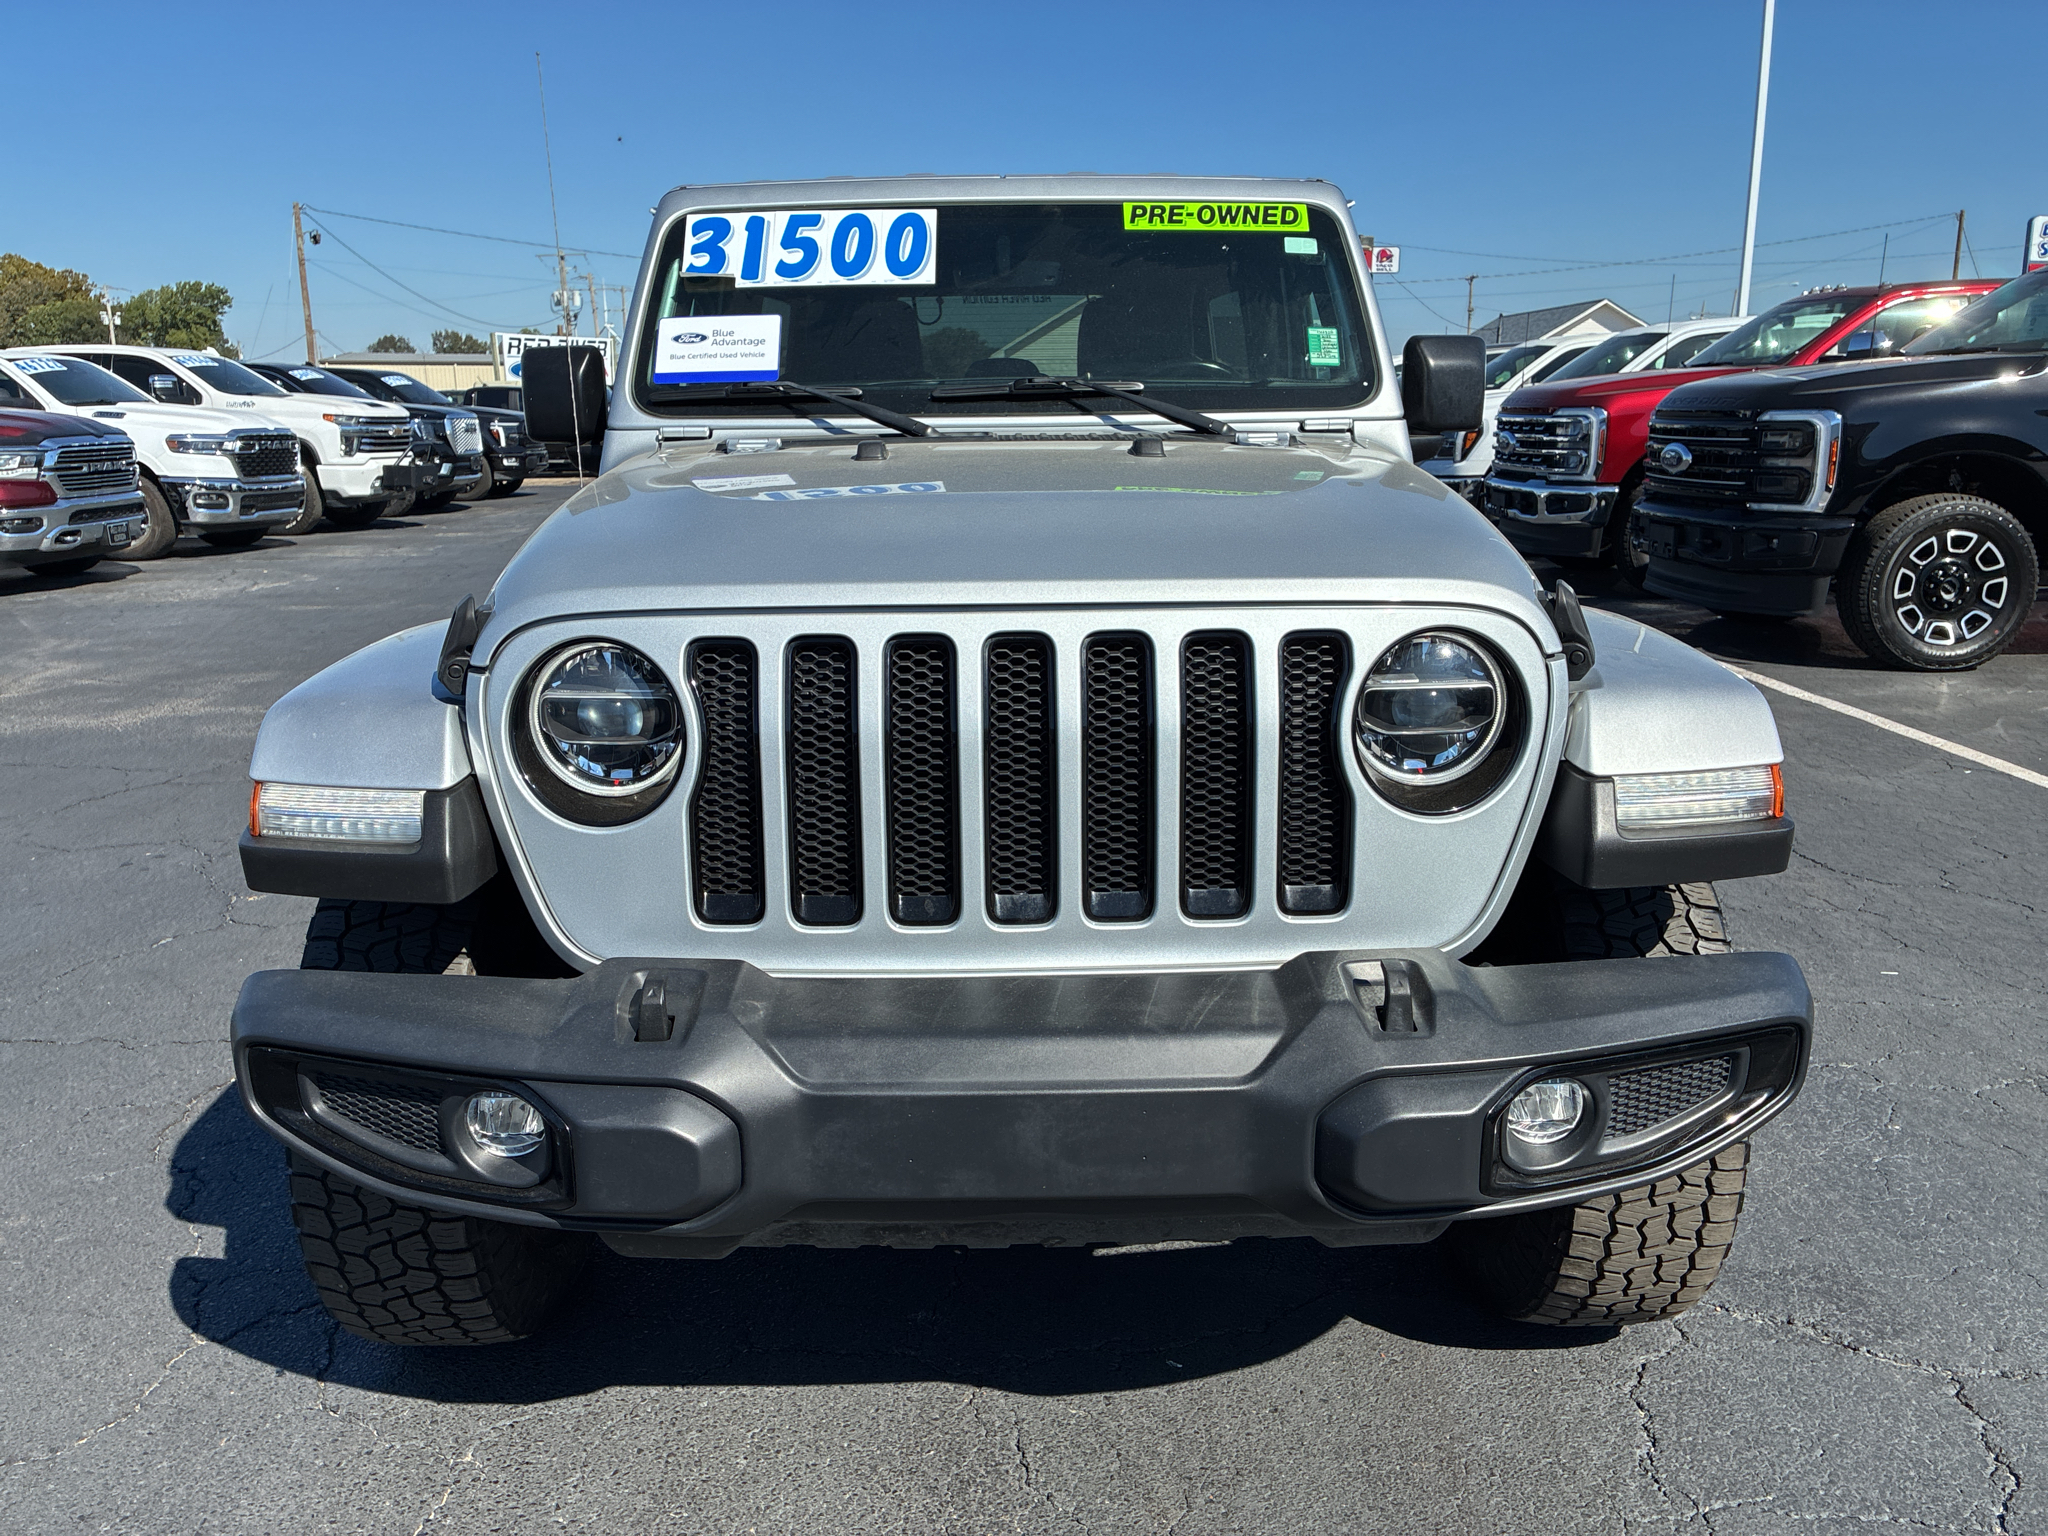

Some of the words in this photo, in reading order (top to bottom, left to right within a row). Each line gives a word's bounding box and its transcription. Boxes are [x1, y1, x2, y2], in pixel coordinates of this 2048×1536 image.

[1129, 204, 1302, 226] PRE-OWNED
[685, 212, 932, 282] 31500
[712, 329, 735, 338] Blue
[711, 338, 766, 346] Advantage
